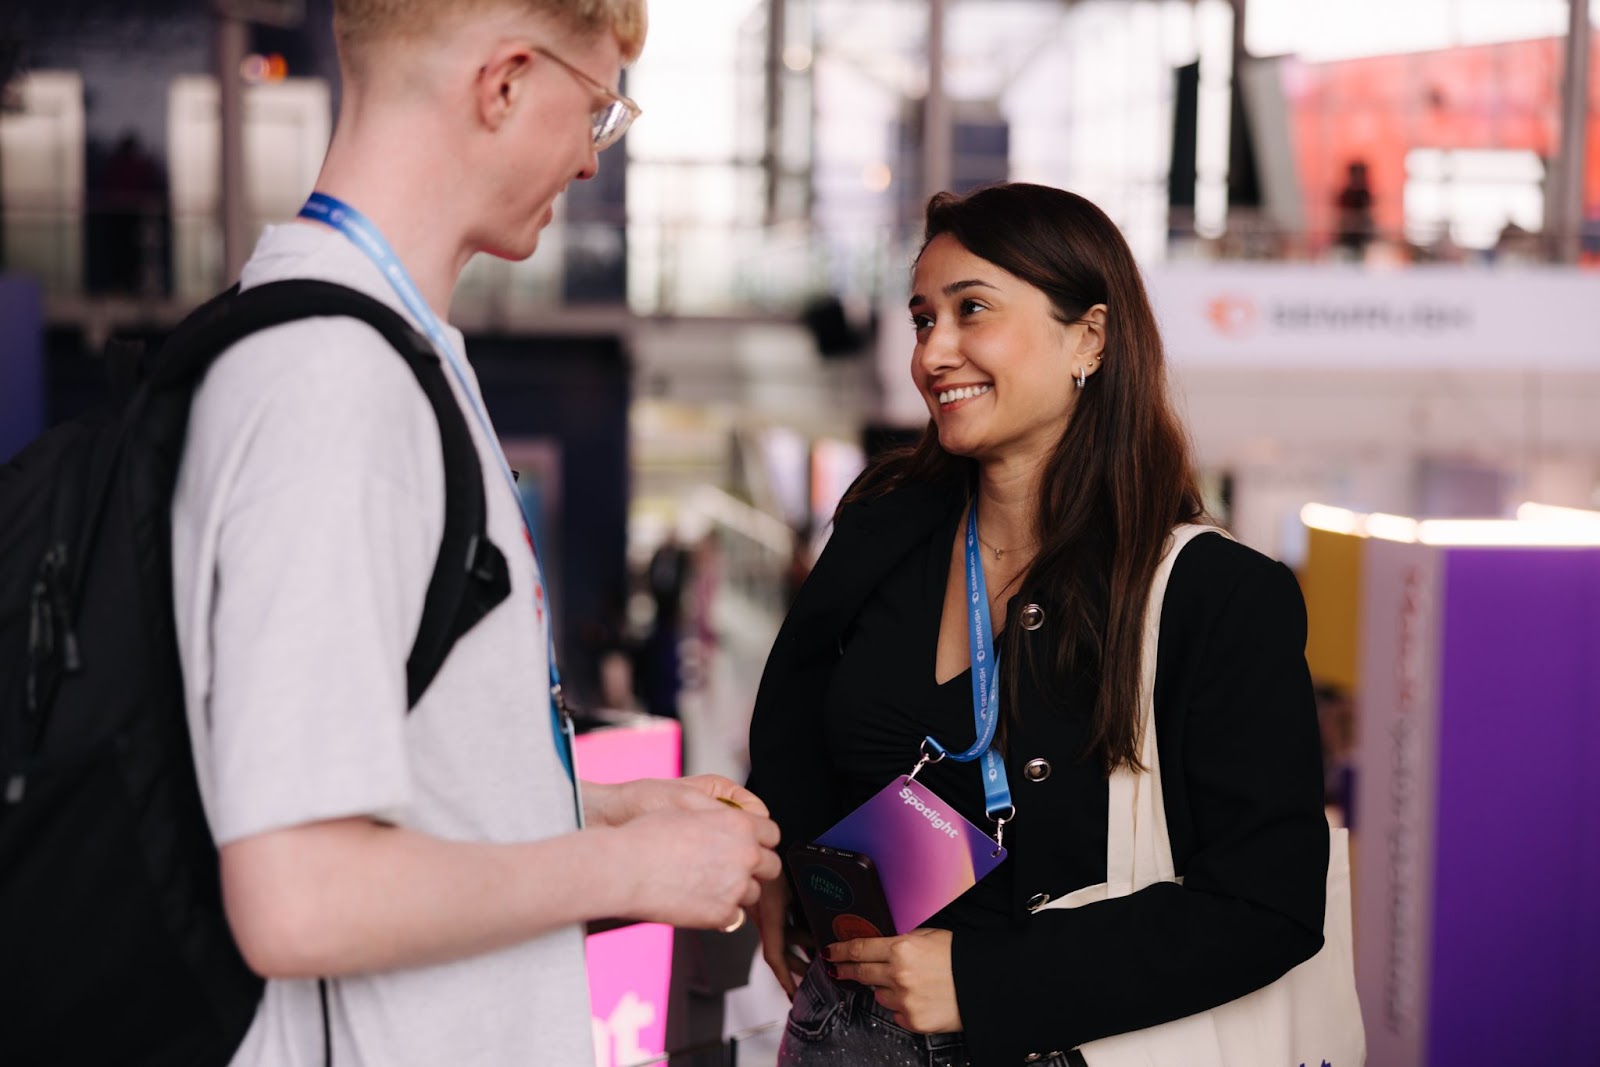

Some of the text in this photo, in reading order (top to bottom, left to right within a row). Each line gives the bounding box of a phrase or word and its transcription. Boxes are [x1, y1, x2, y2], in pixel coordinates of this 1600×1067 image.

[970, 551, 979, 592] SEMRUSH
[974, 609, 984, 650] SEMRUSH
[979, 667, 988, 707] SEMRUSH
[899, 787, 959, 838] Spotlight
